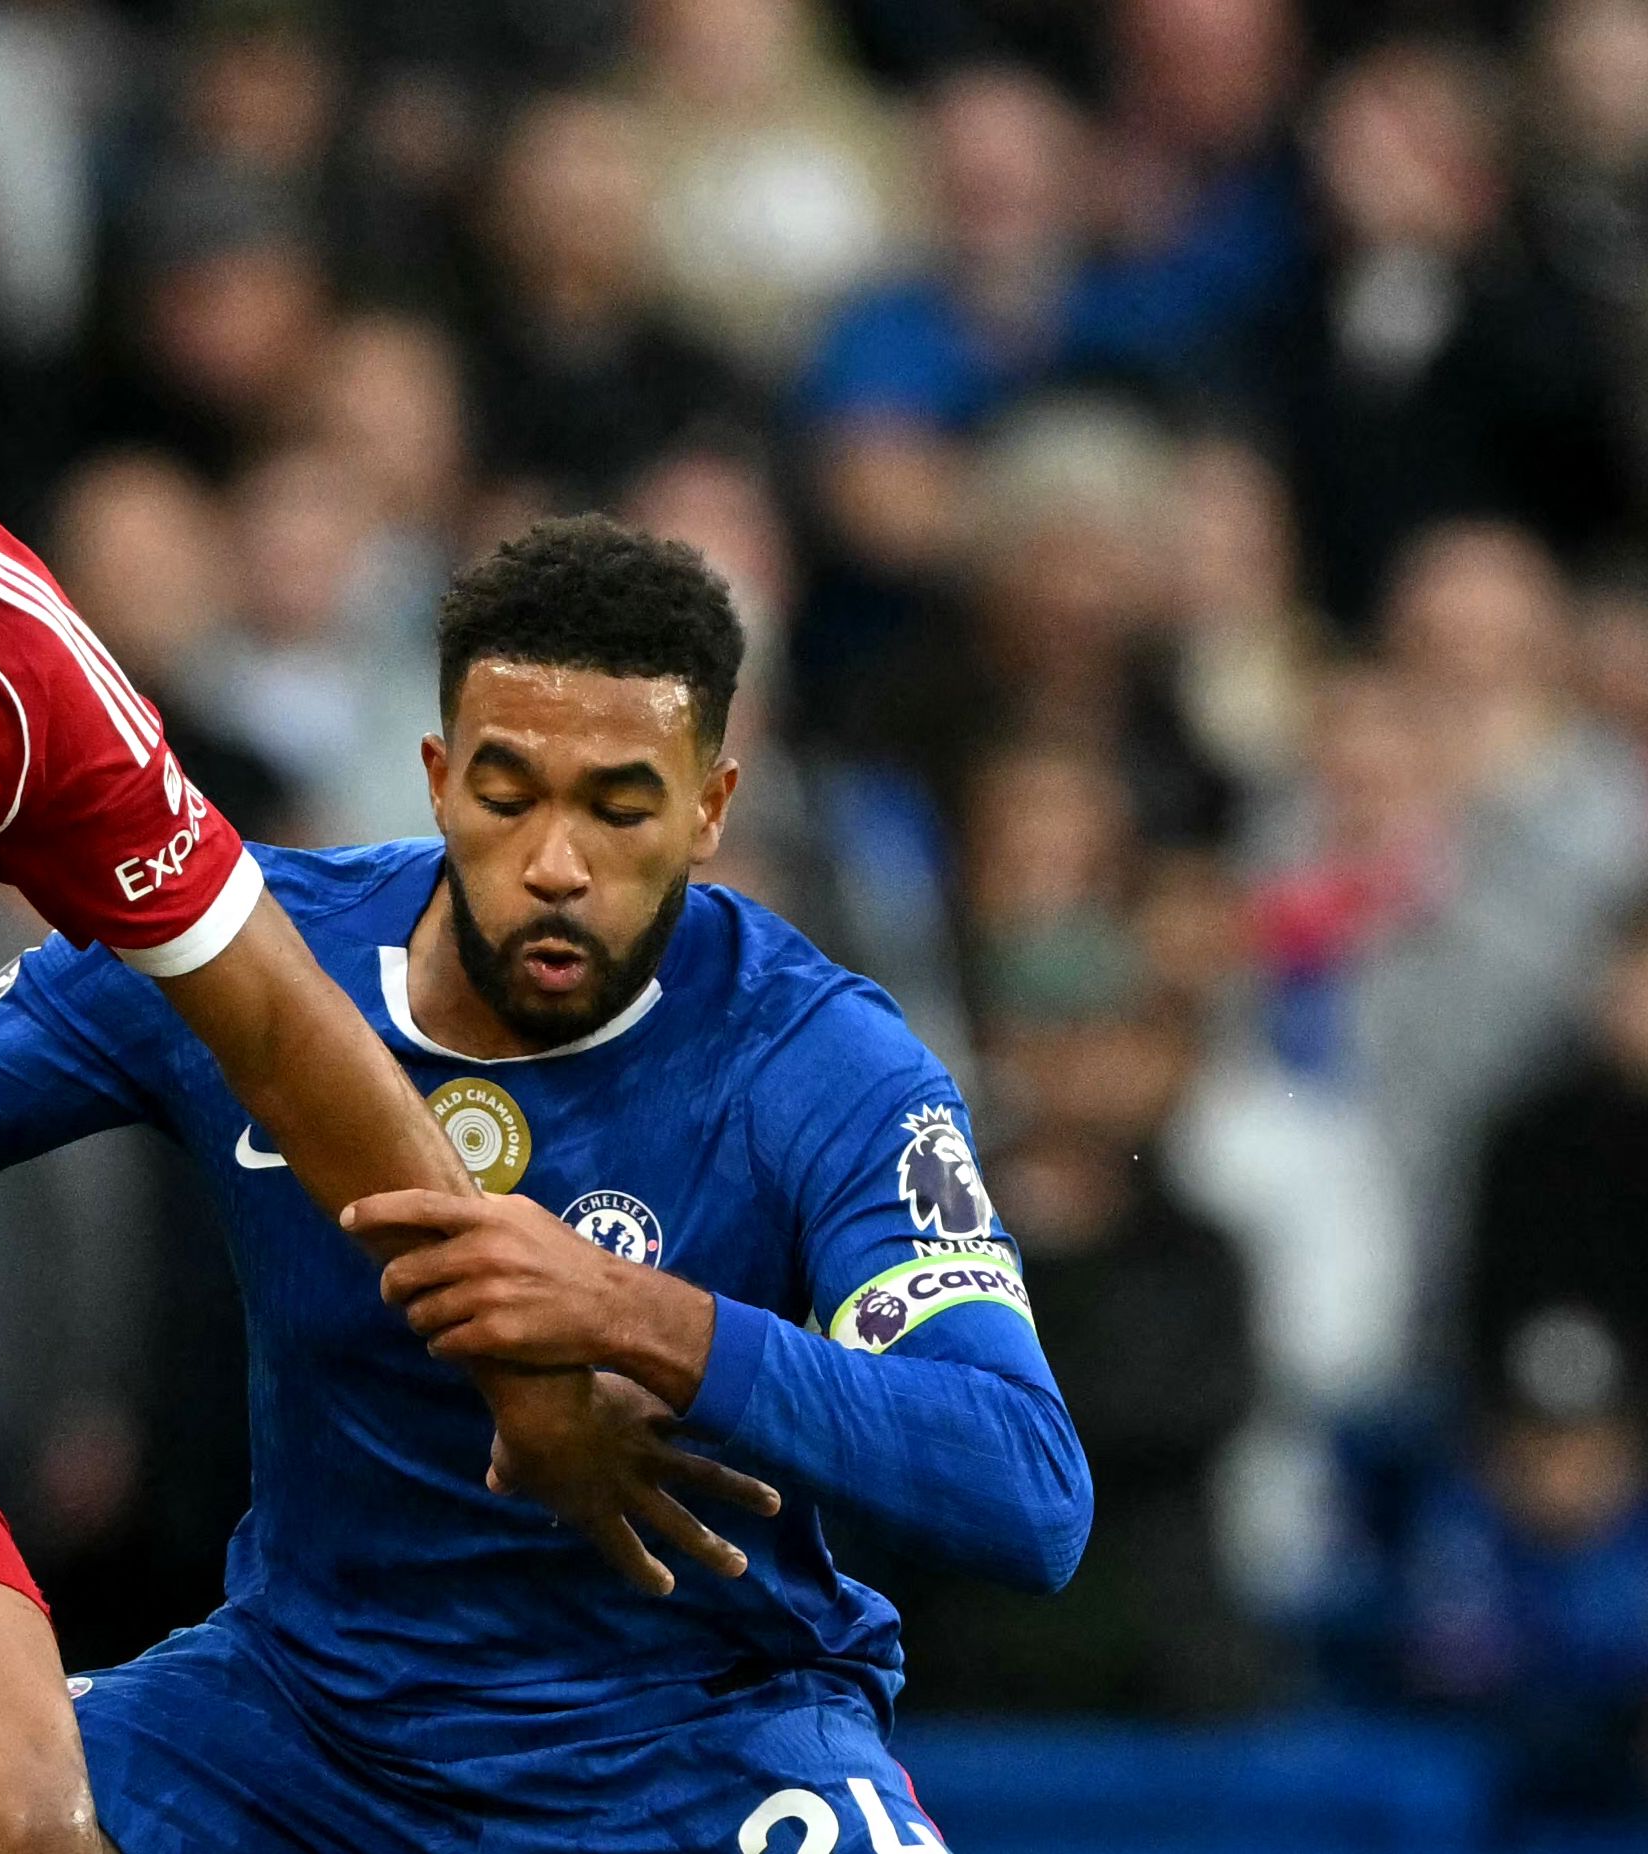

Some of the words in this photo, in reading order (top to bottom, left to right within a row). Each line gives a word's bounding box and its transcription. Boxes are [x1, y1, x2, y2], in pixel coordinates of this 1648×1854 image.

[435, 1091, 463, 1119] RLD
[466, 1088, 520, 1167] CHAMPIONS
[578, 1195, 649, 1226] CHELSEA
[907, 1270, 1030, 1311] Capta
